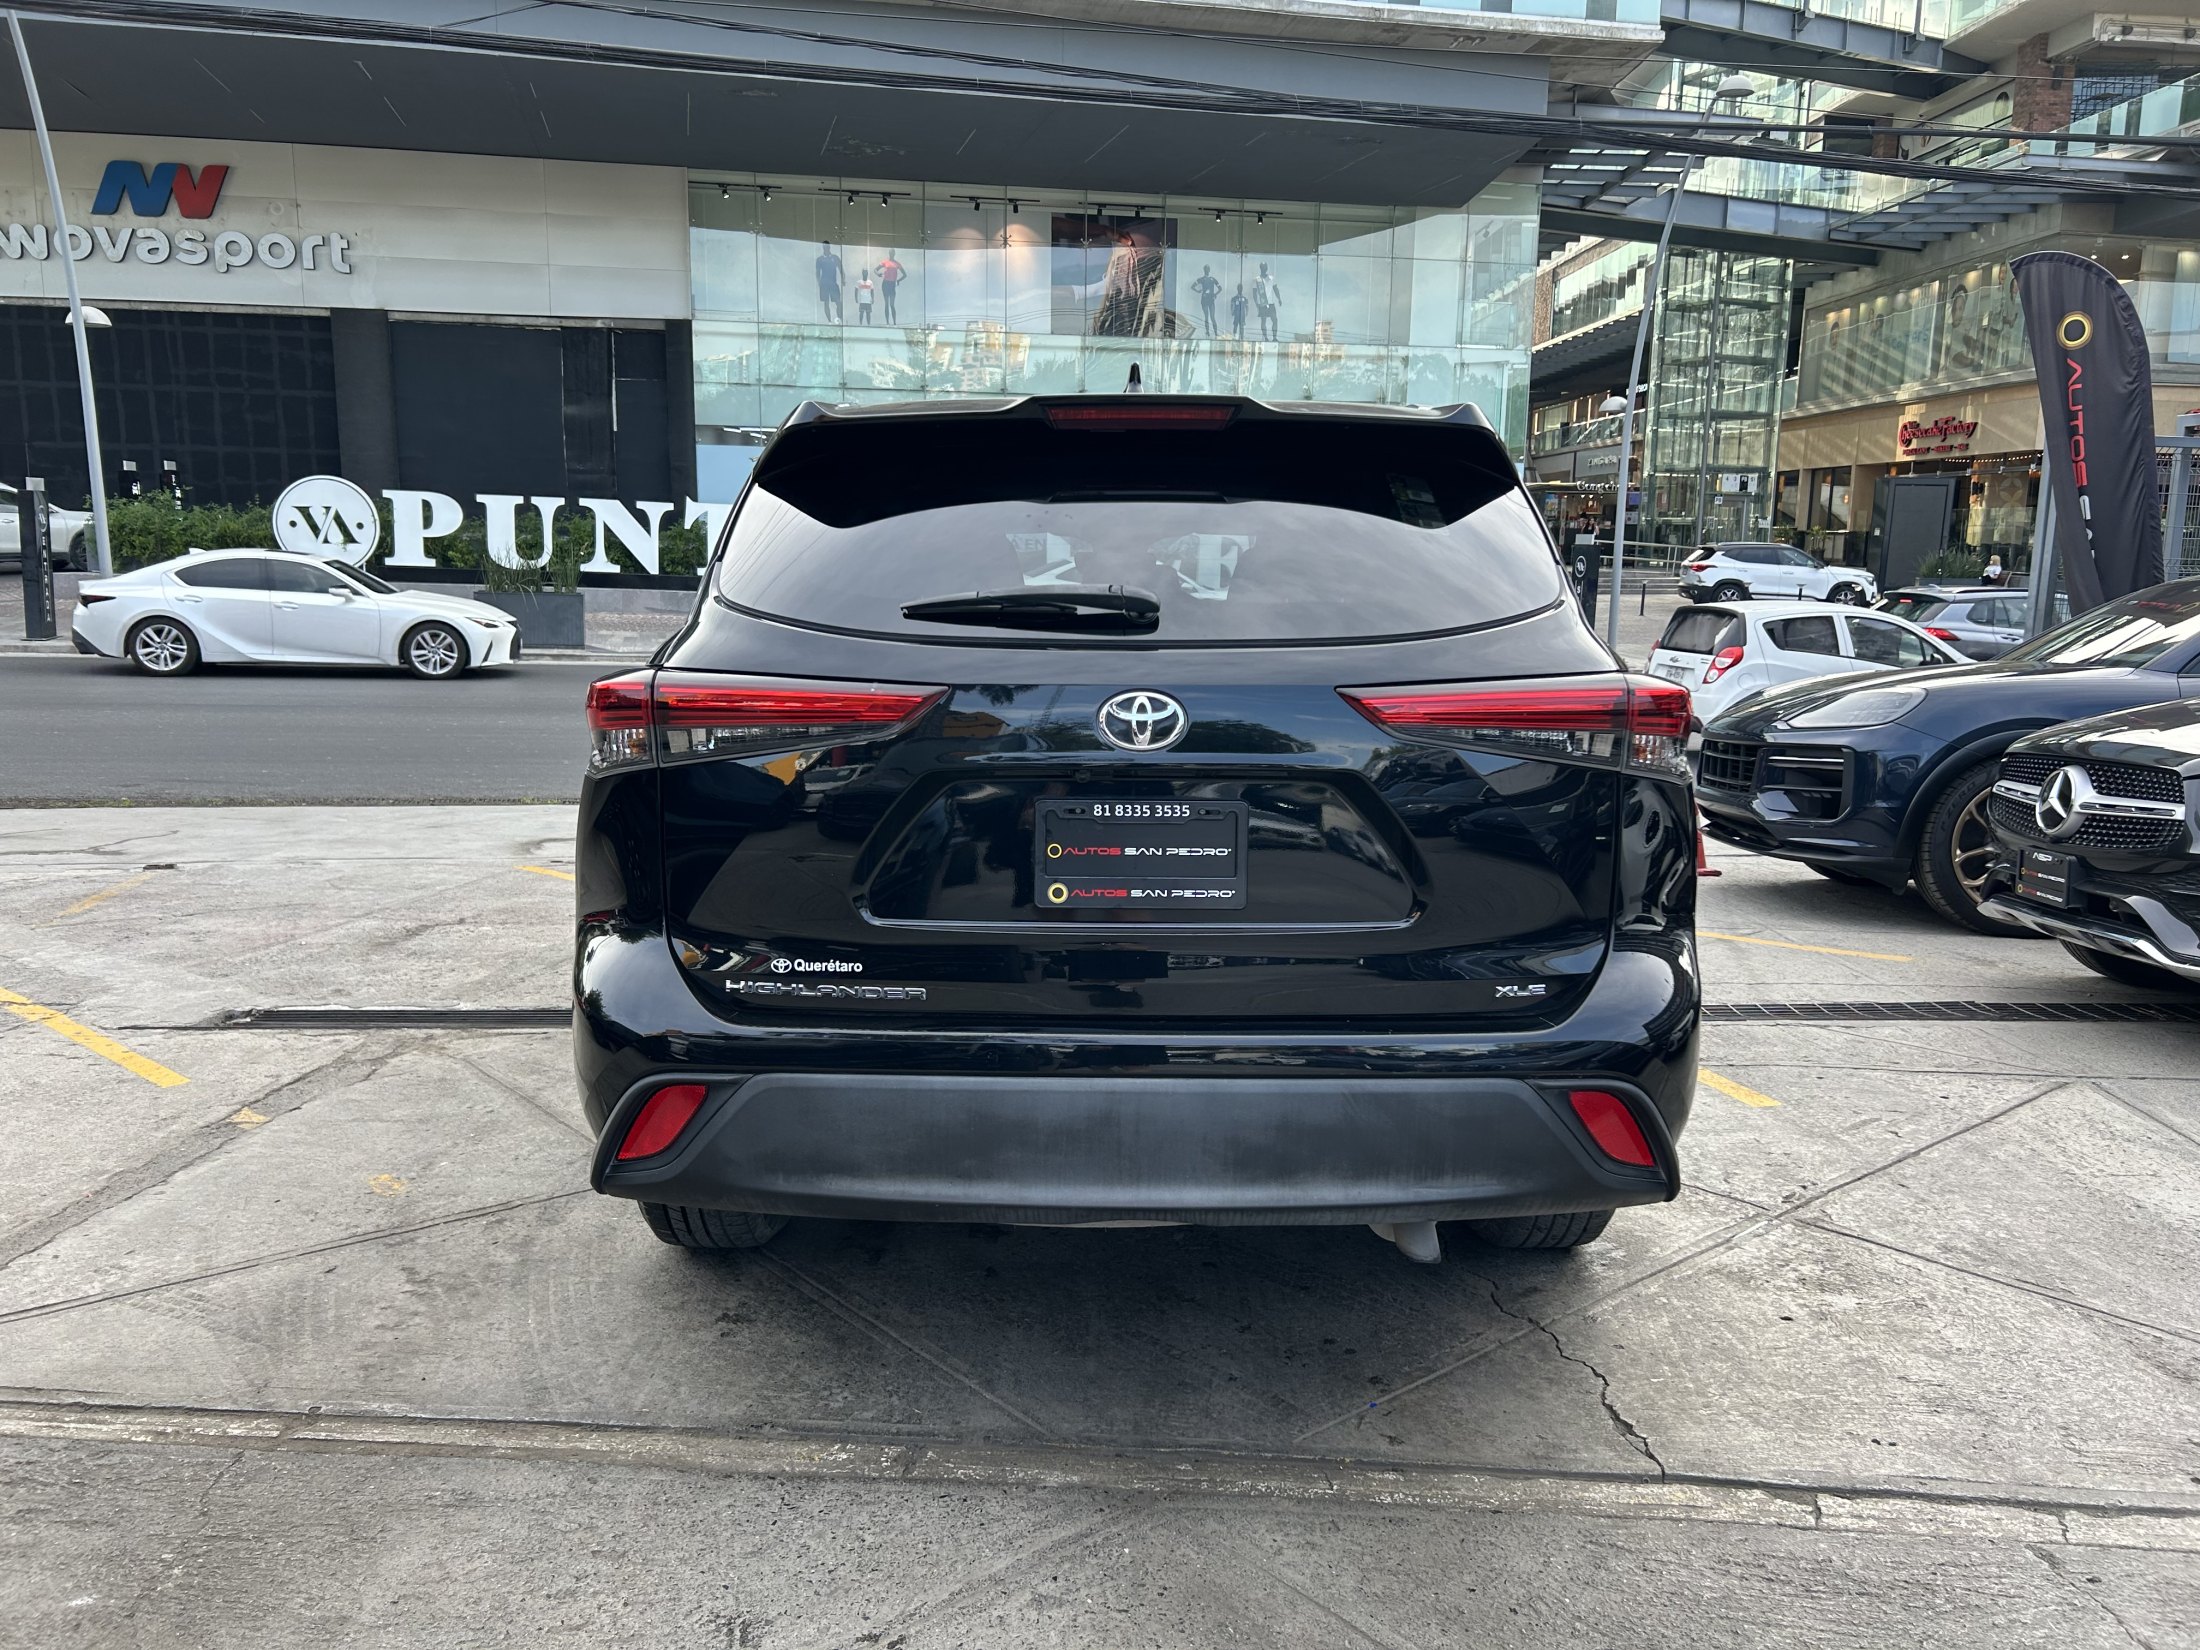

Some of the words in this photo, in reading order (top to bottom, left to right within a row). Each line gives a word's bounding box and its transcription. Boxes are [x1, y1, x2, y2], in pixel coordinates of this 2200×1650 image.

[1938, 416, 1978, 442] Factory
[2066, 358, 2088, 488] AUTOS
[1093, 805, 1111, 817] 81
[1115, 805, 1150, 817] 8335
[1155, 805, 1190, 817] 3535
[1064, 847, 1121, 855] AUTOS
[1124, 847, 1162, 856] SAN
[1166, 848, 1229, 856] PEDRO
[1131, 889, 1168, 898] SAN
[1171, 890, 1233, 898] PEDRO
[794, 959, 863, 972] Querétaro
[725, 979, 927, 1001] HIGHLANDER
[1495, 984, 1546, 998] XLE
